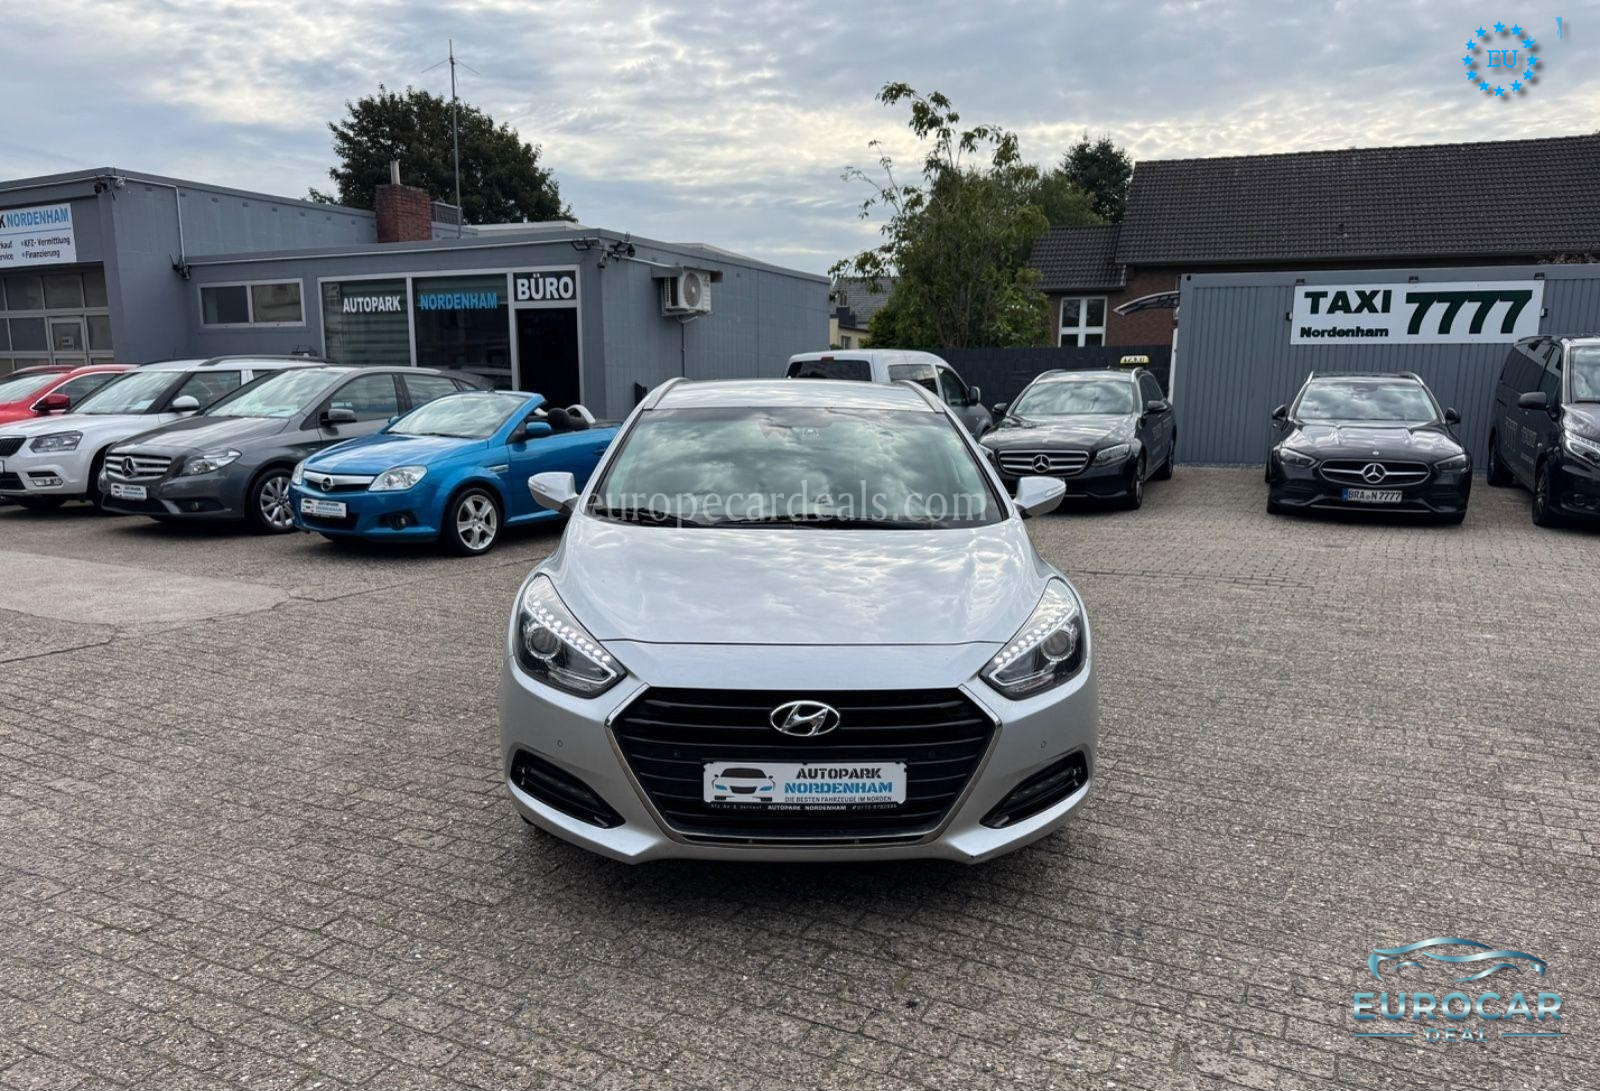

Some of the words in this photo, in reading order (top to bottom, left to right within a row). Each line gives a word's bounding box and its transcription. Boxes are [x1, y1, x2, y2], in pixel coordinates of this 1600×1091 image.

[6, 208, 69, 227] NORDENHAM
[516, 273, 574, 300] BÜRO
[343, 296, 401, 313] AUTOPARK
[420, 292, 497, 311] NORDENHAM
[1304, 289, 1392, 315] TAXI
[1405, 289, 1533, 335] 7777
[1300, 326, 1389, 338] Nordenham
[796, 768, 882, 779] AUTOPARK
[784, 782, 893, 793] NORDENHAM
